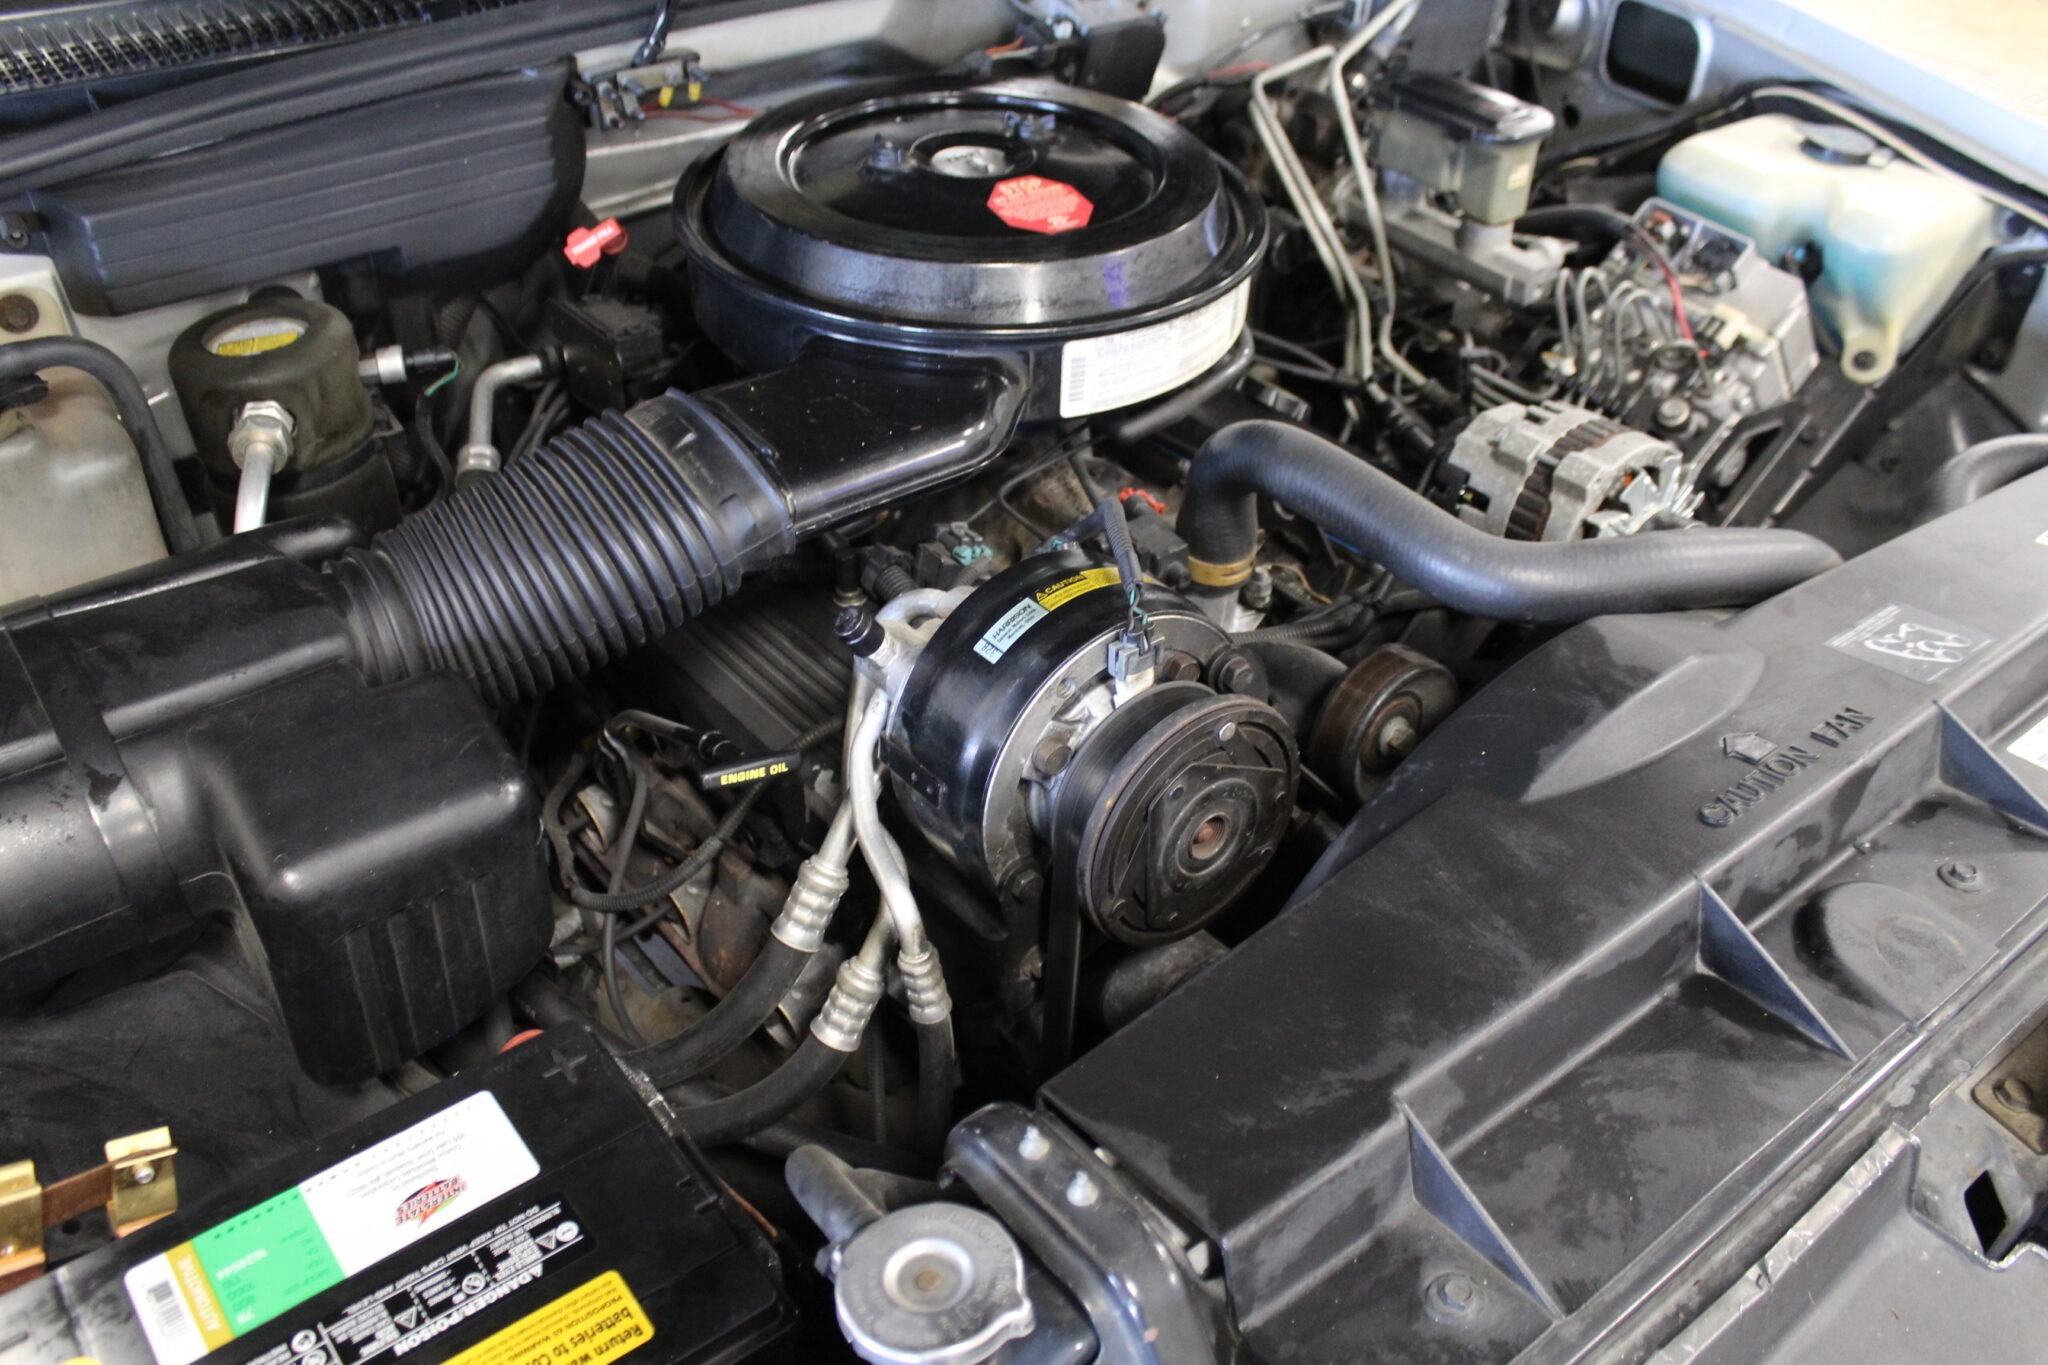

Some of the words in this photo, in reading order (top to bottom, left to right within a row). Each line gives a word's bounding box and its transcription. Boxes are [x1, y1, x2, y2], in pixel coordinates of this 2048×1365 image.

[998, 178, 1041, 197] STOP
[1045, 574, 1084, 594] CAUTION
[993, 604, 1031, 639] HARRISON
[720, 767, 766, 785] ENGINE
[770, 762, 789, 775] OIL
[1698, 746, 1820, 828] CAUTION
[1810, 707, 1874, 748] FAN
[394, 1185, 465, 1225] INTERSTATE
[396, 1177, 459, 1214] BATTERIES
[521, 1203, 540, 1218] DO
[505, 1213, 524, 1227] NOT
[466, 1230, 492, 1248] KEEP
[175, 1253, 223, 1333] AUTOMOTIVE
[392, 1270, 532, 1356] DANGER/POISON
[564, 1294, 622, 1330] PROPOSITION
[568, 1306, 632, 1351] batteries
[551, 1342, 569, 1359] to
[591, 1323, 643, 1357] Return
